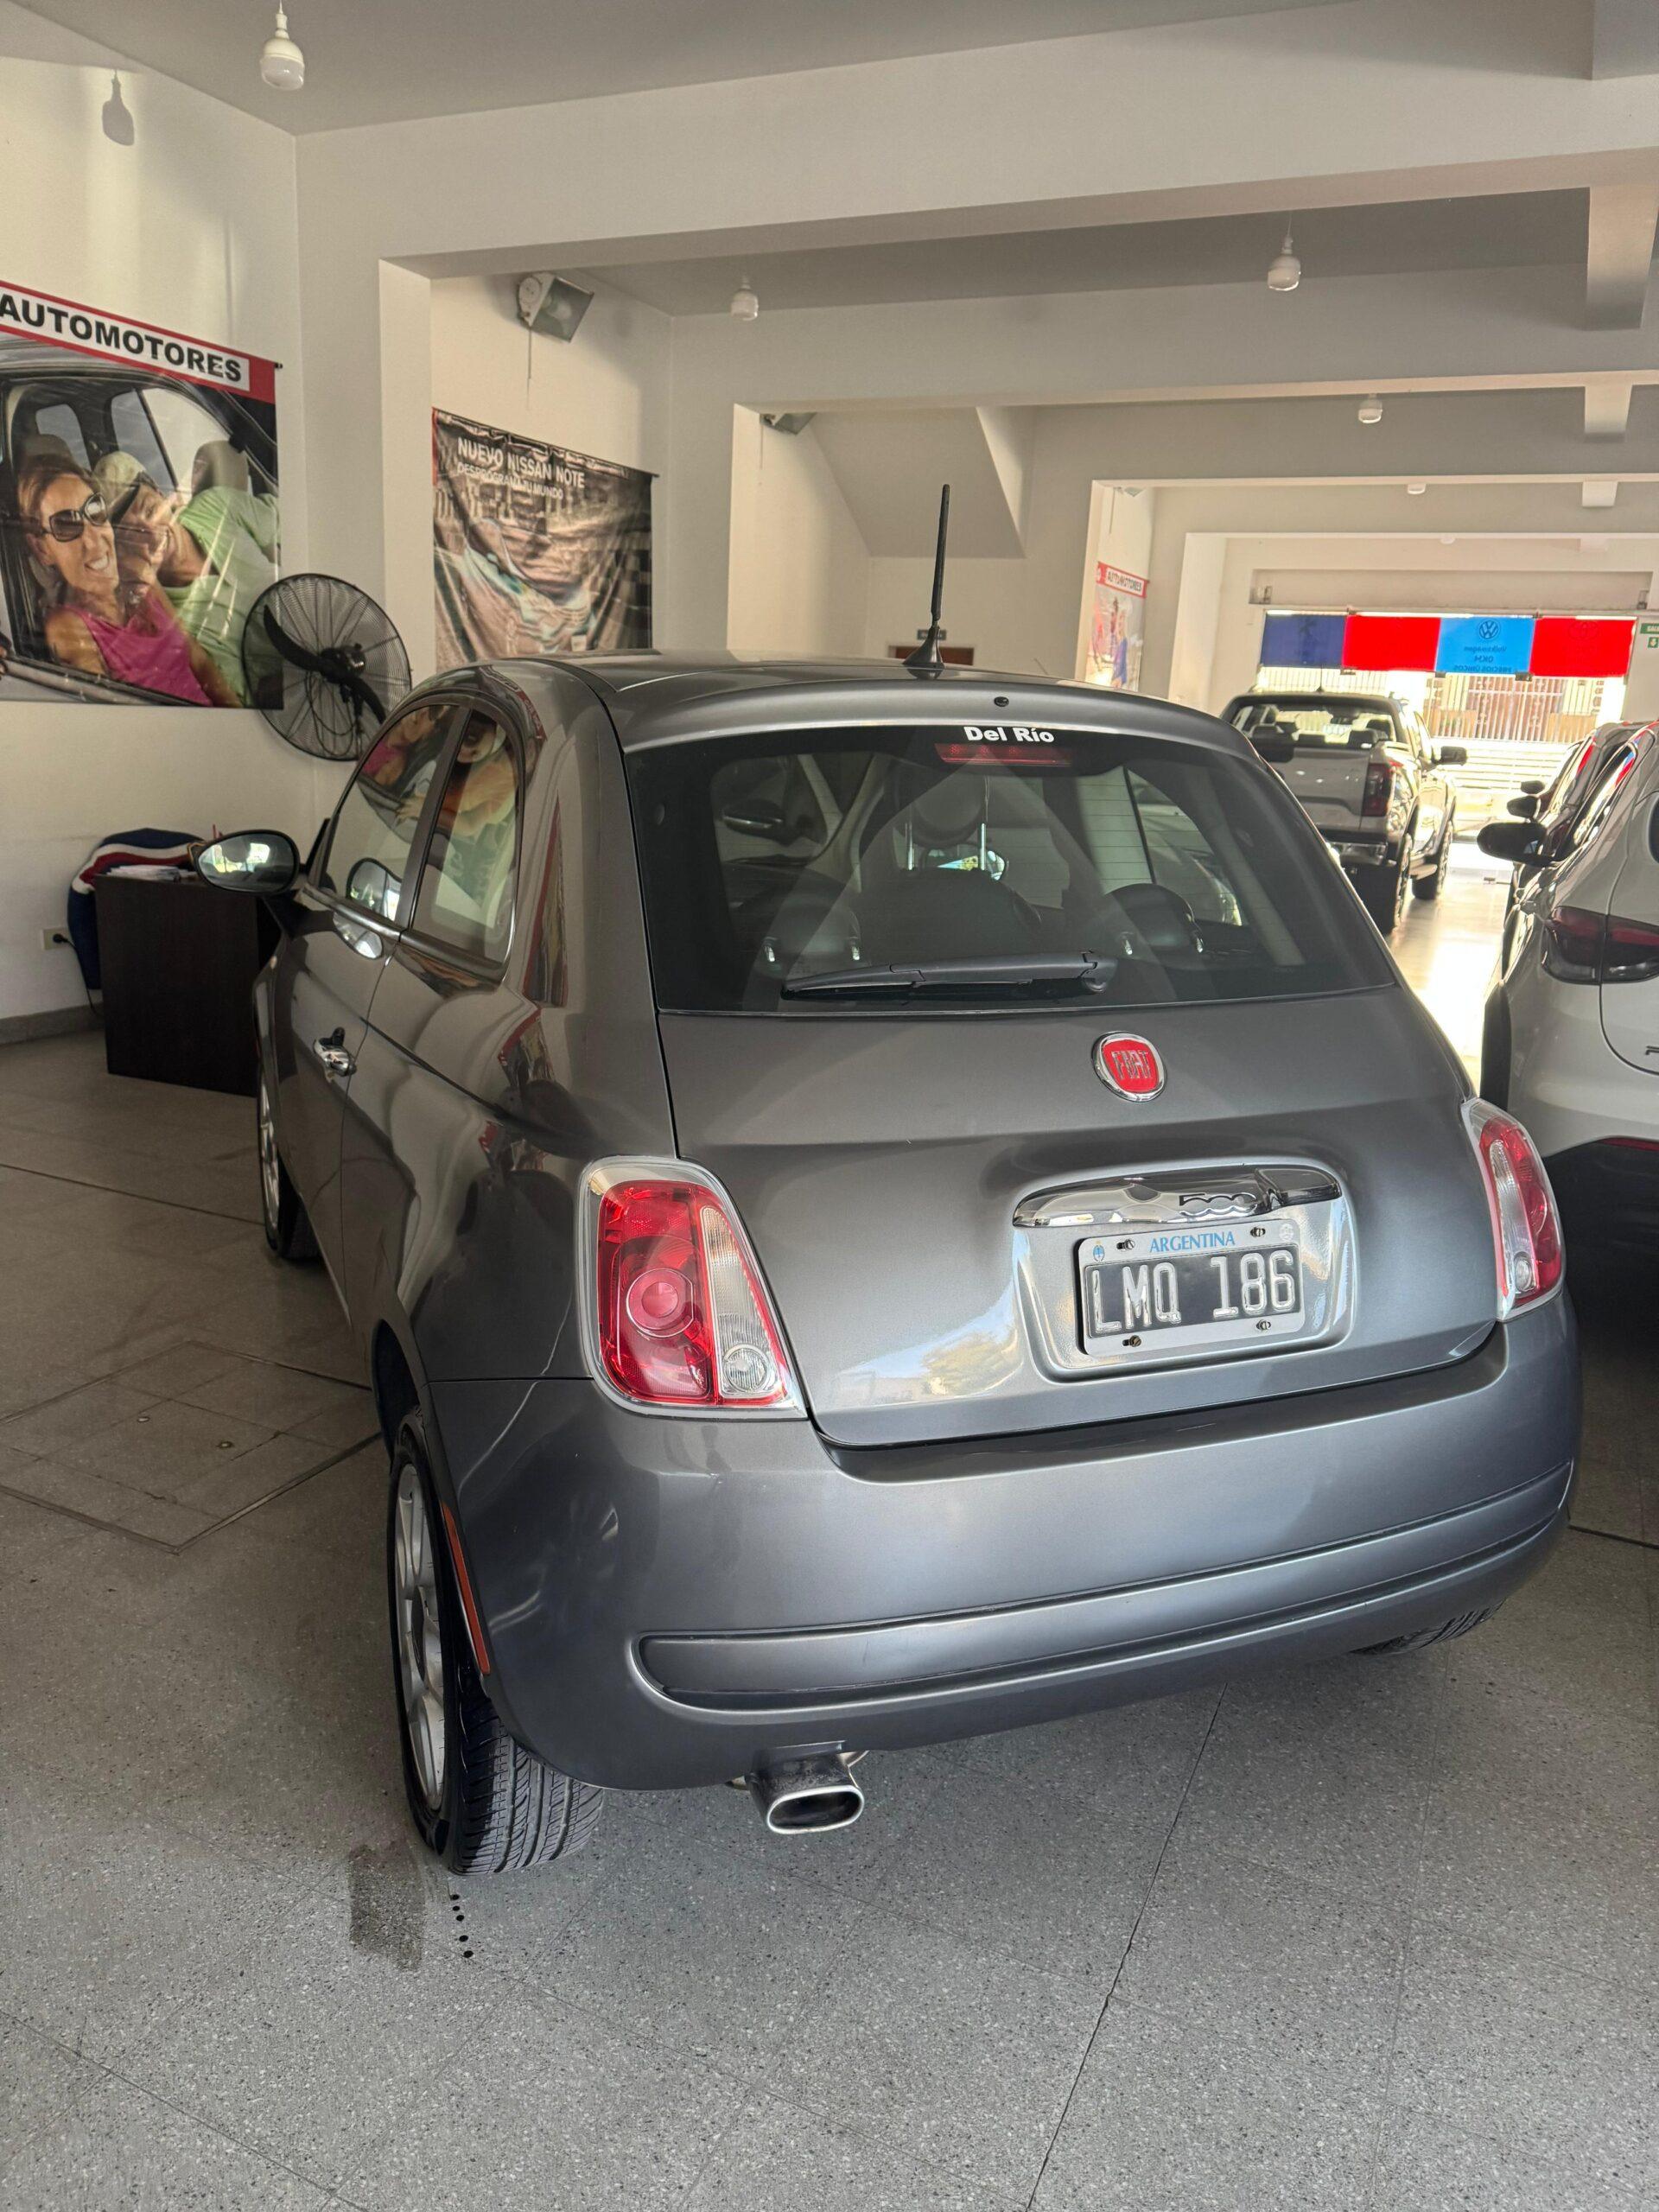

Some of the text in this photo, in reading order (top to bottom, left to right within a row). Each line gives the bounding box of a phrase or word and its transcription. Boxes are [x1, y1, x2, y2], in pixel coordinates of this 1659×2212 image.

[0, 293, 243, 383] AUTOMOTORES
[457, 436, 586, 489] NUEVO NISSAN NOTE
[532, 482, 563, 500] MUNDO
[963, 726, 1055, 743] Del Río
[1110, 1049, 1153, 1080] FIAT
[1179, 1192, 1258, 1217] 500
[1149, 1230, 1236, 1253] ARGENTINA
[1091, 1249, 1296, 1334] LMQ 186
